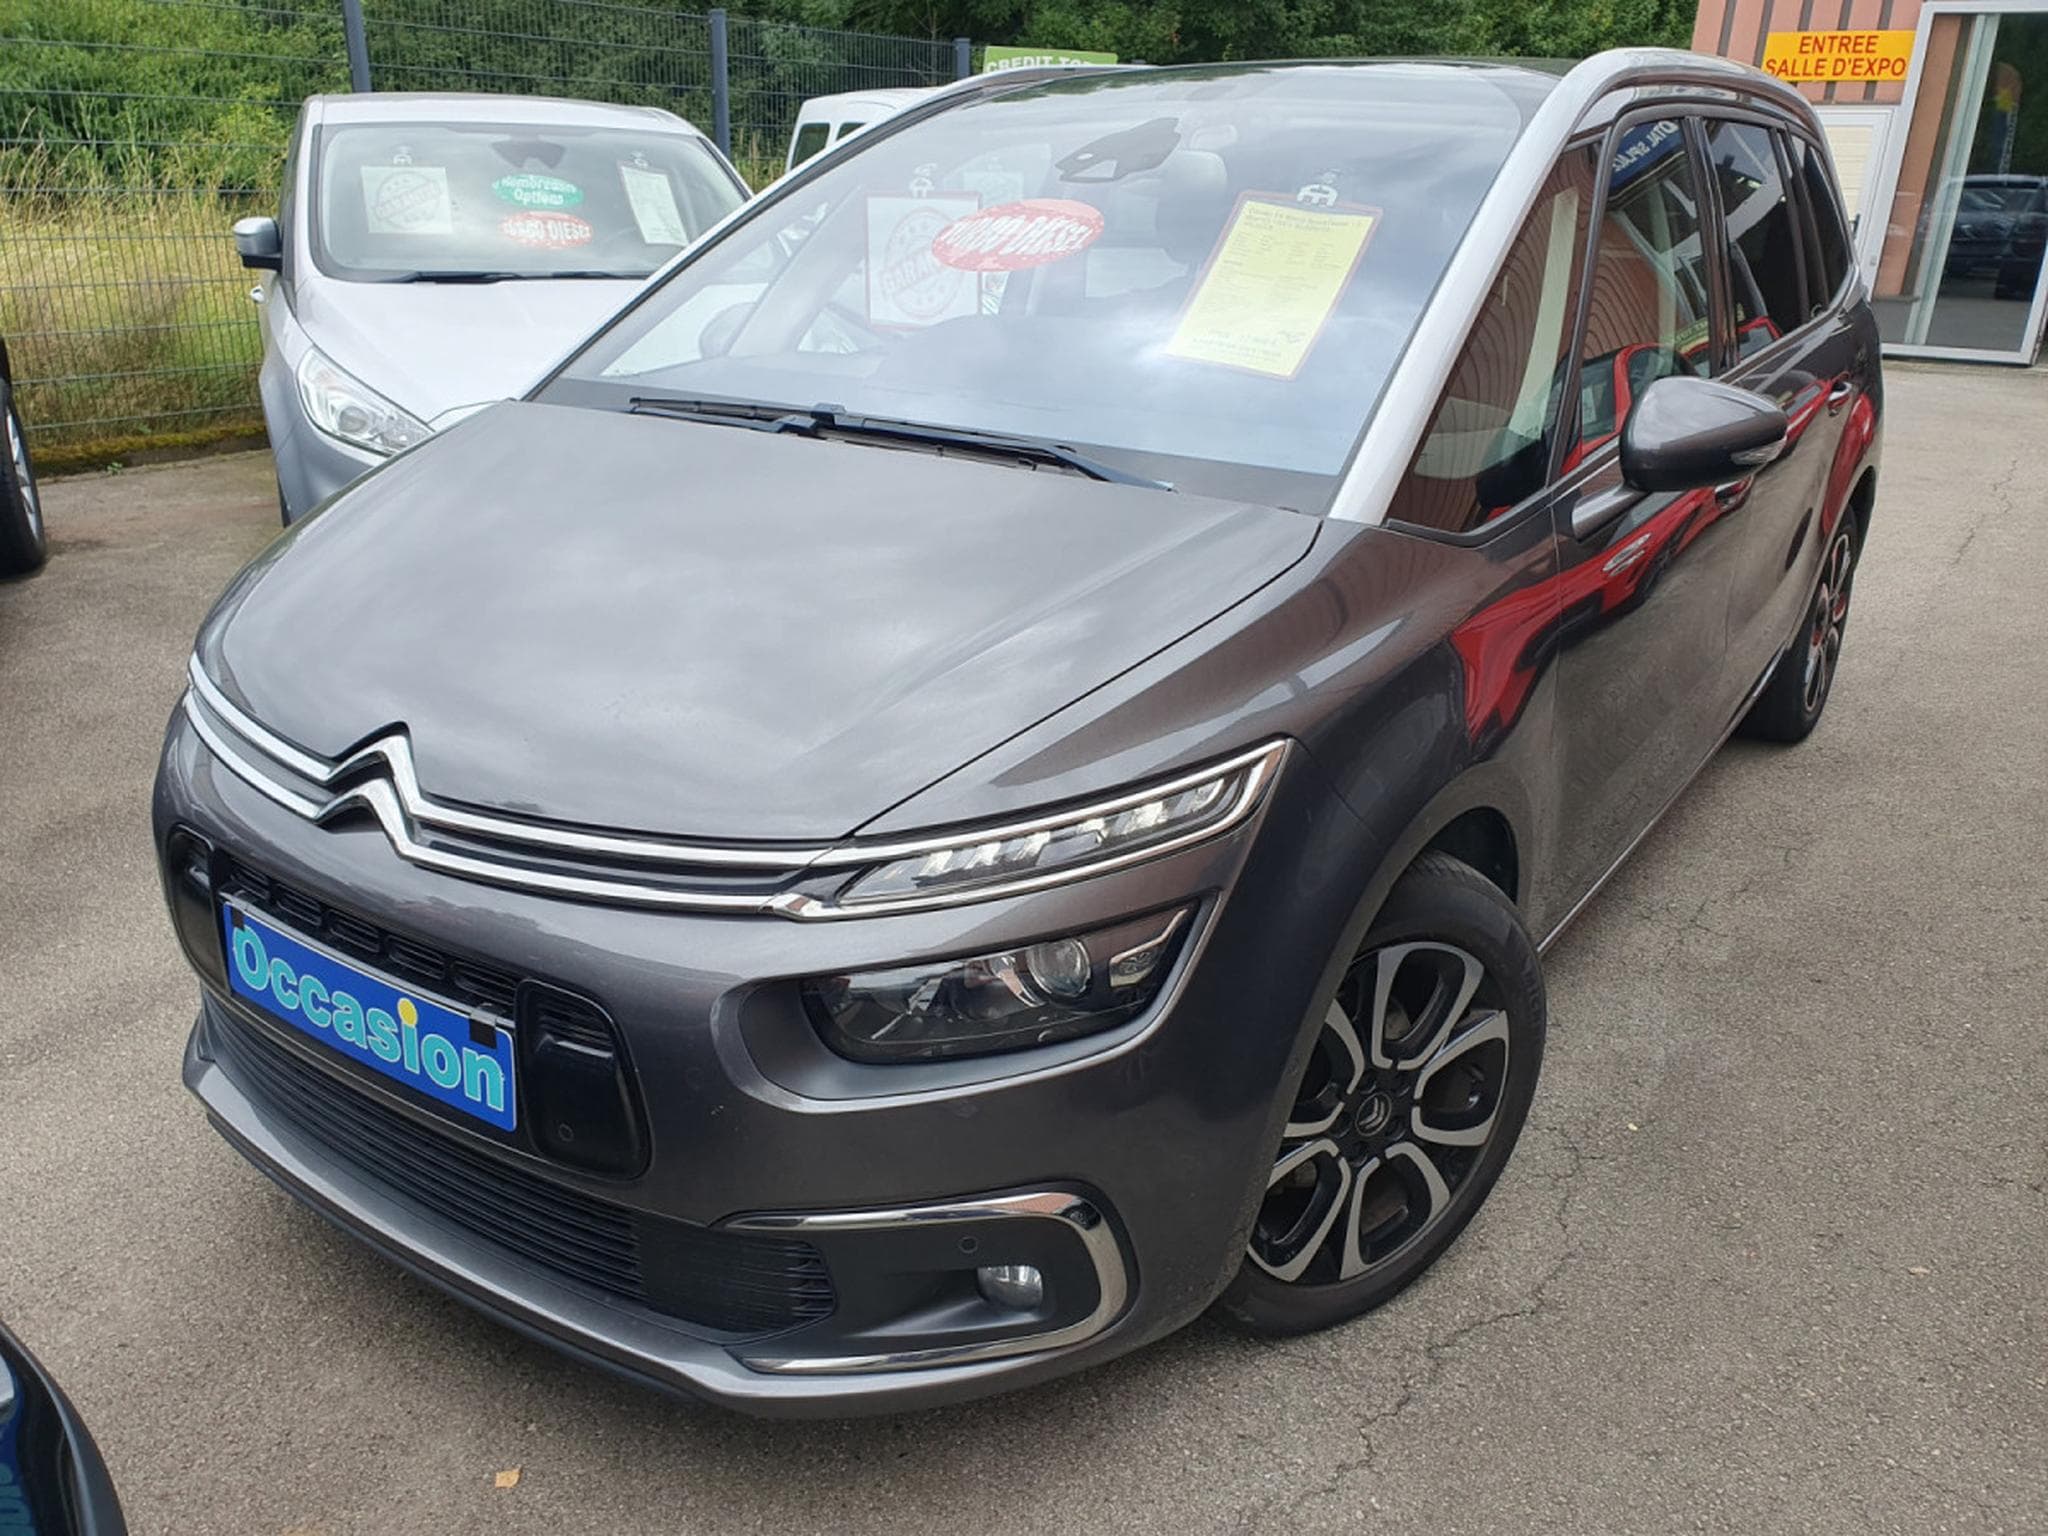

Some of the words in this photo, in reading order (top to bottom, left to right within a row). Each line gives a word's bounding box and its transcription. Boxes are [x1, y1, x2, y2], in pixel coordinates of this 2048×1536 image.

[1799, 35, 1879, 54] ENTREE
[1766, 58, 1827, 77] SALLE
[1832, 57, 1907, 77] D'EXPO
[232, 925, 504, 1112] Occasion
